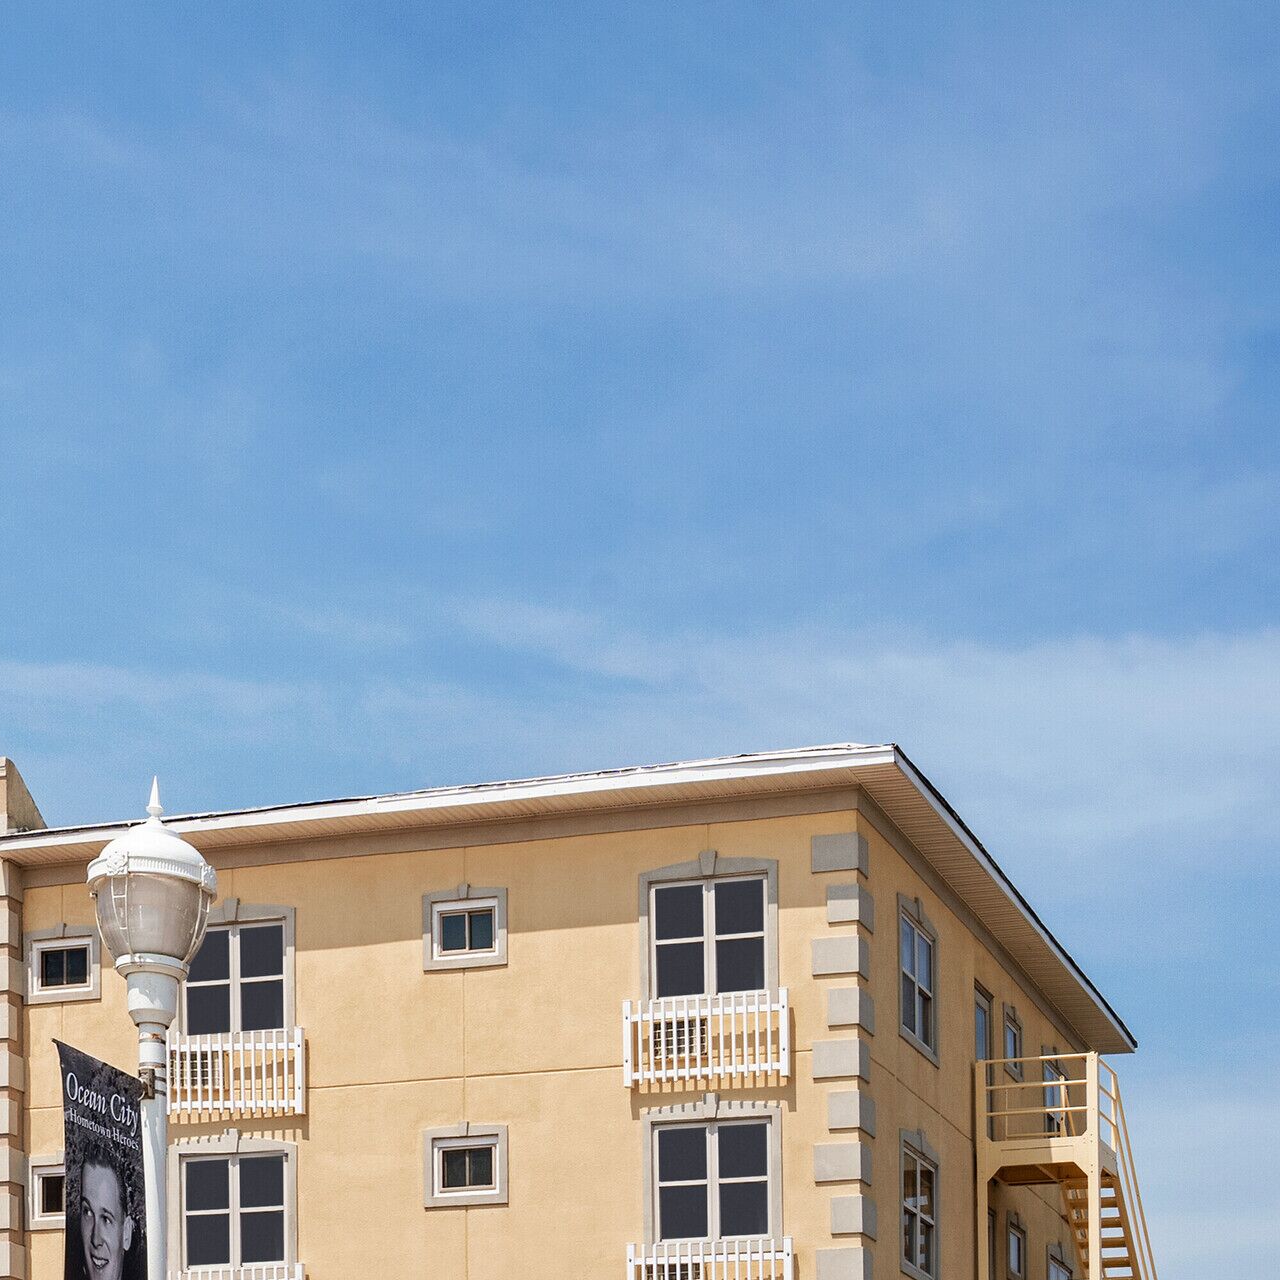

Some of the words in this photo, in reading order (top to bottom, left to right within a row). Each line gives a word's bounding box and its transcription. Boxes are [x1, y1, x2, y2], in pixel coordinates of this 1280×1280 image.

[67, 1072, 107, 1114] Ocean
[110, 1094, 138, 1136] City
[69, 1108, 111, 1138] Hometown
[113, 1127, 139, 1150] Heroes
